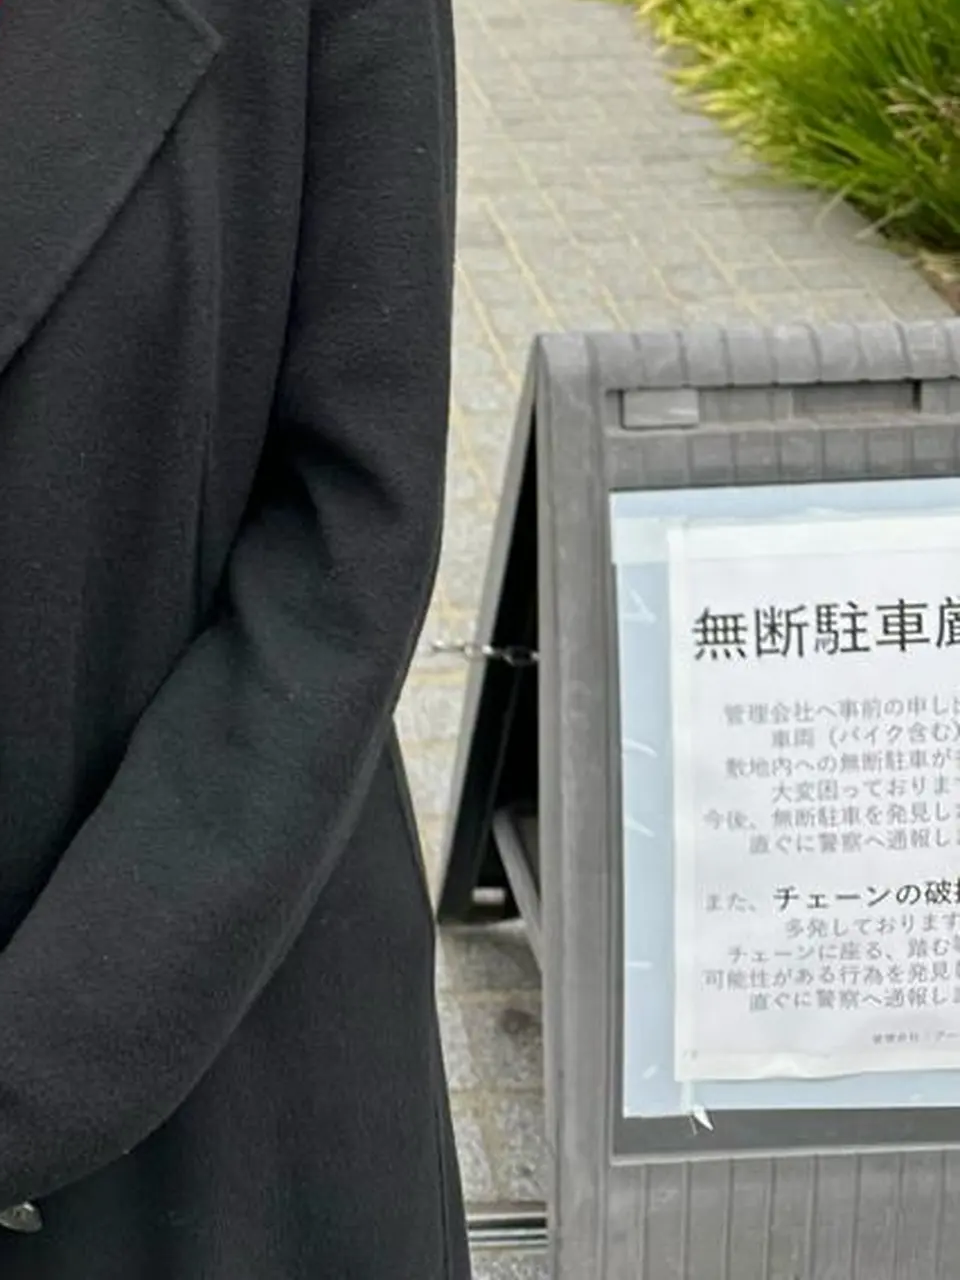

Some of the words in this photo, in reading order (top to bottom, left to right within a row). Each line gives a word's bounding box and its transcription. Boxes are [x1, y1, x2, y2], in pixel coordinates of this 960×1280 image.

[749, 828, 960, 856] 直ぐに警察へ通報し
